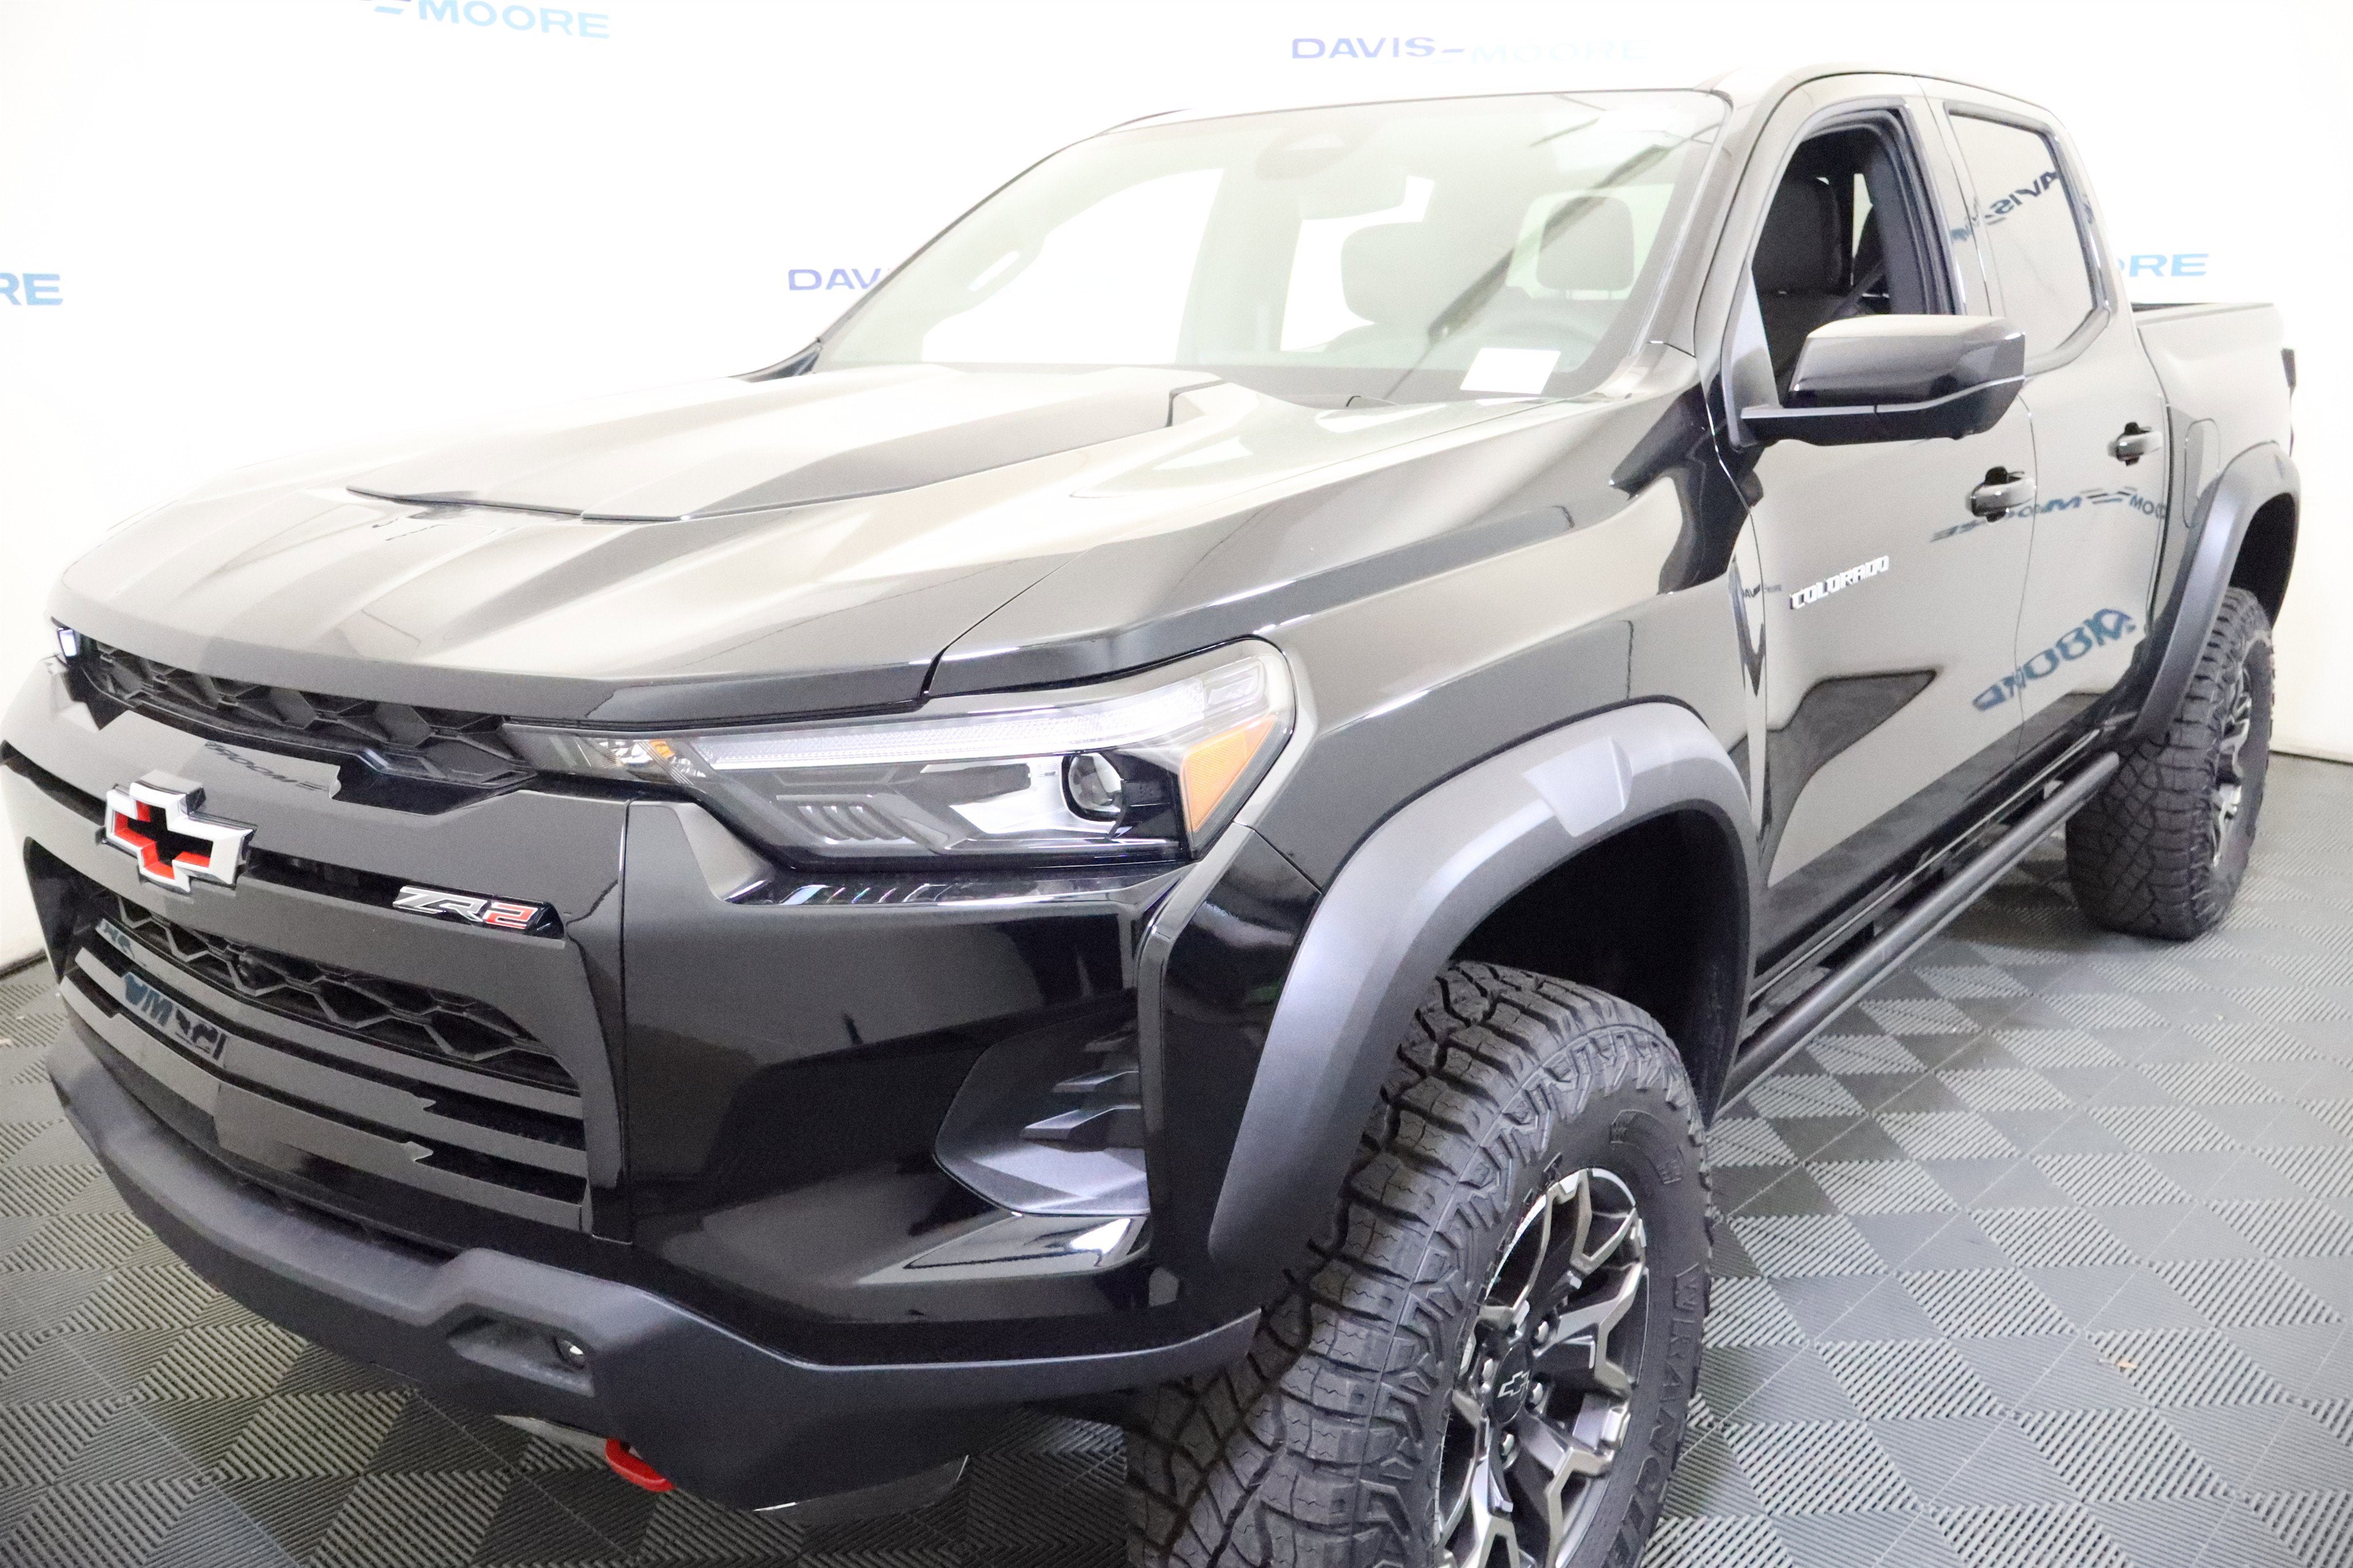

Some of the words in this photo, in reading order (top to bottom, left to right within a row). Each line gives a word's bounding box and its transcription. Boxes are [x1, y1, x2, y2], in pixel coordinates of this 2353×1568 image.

[788, 268, 882, 291] DAV
[2119, 253, 2209, 277] RE
[1790, 555, 1889, 609] COLORADO
[393, 886, 538, 929] ZR2
